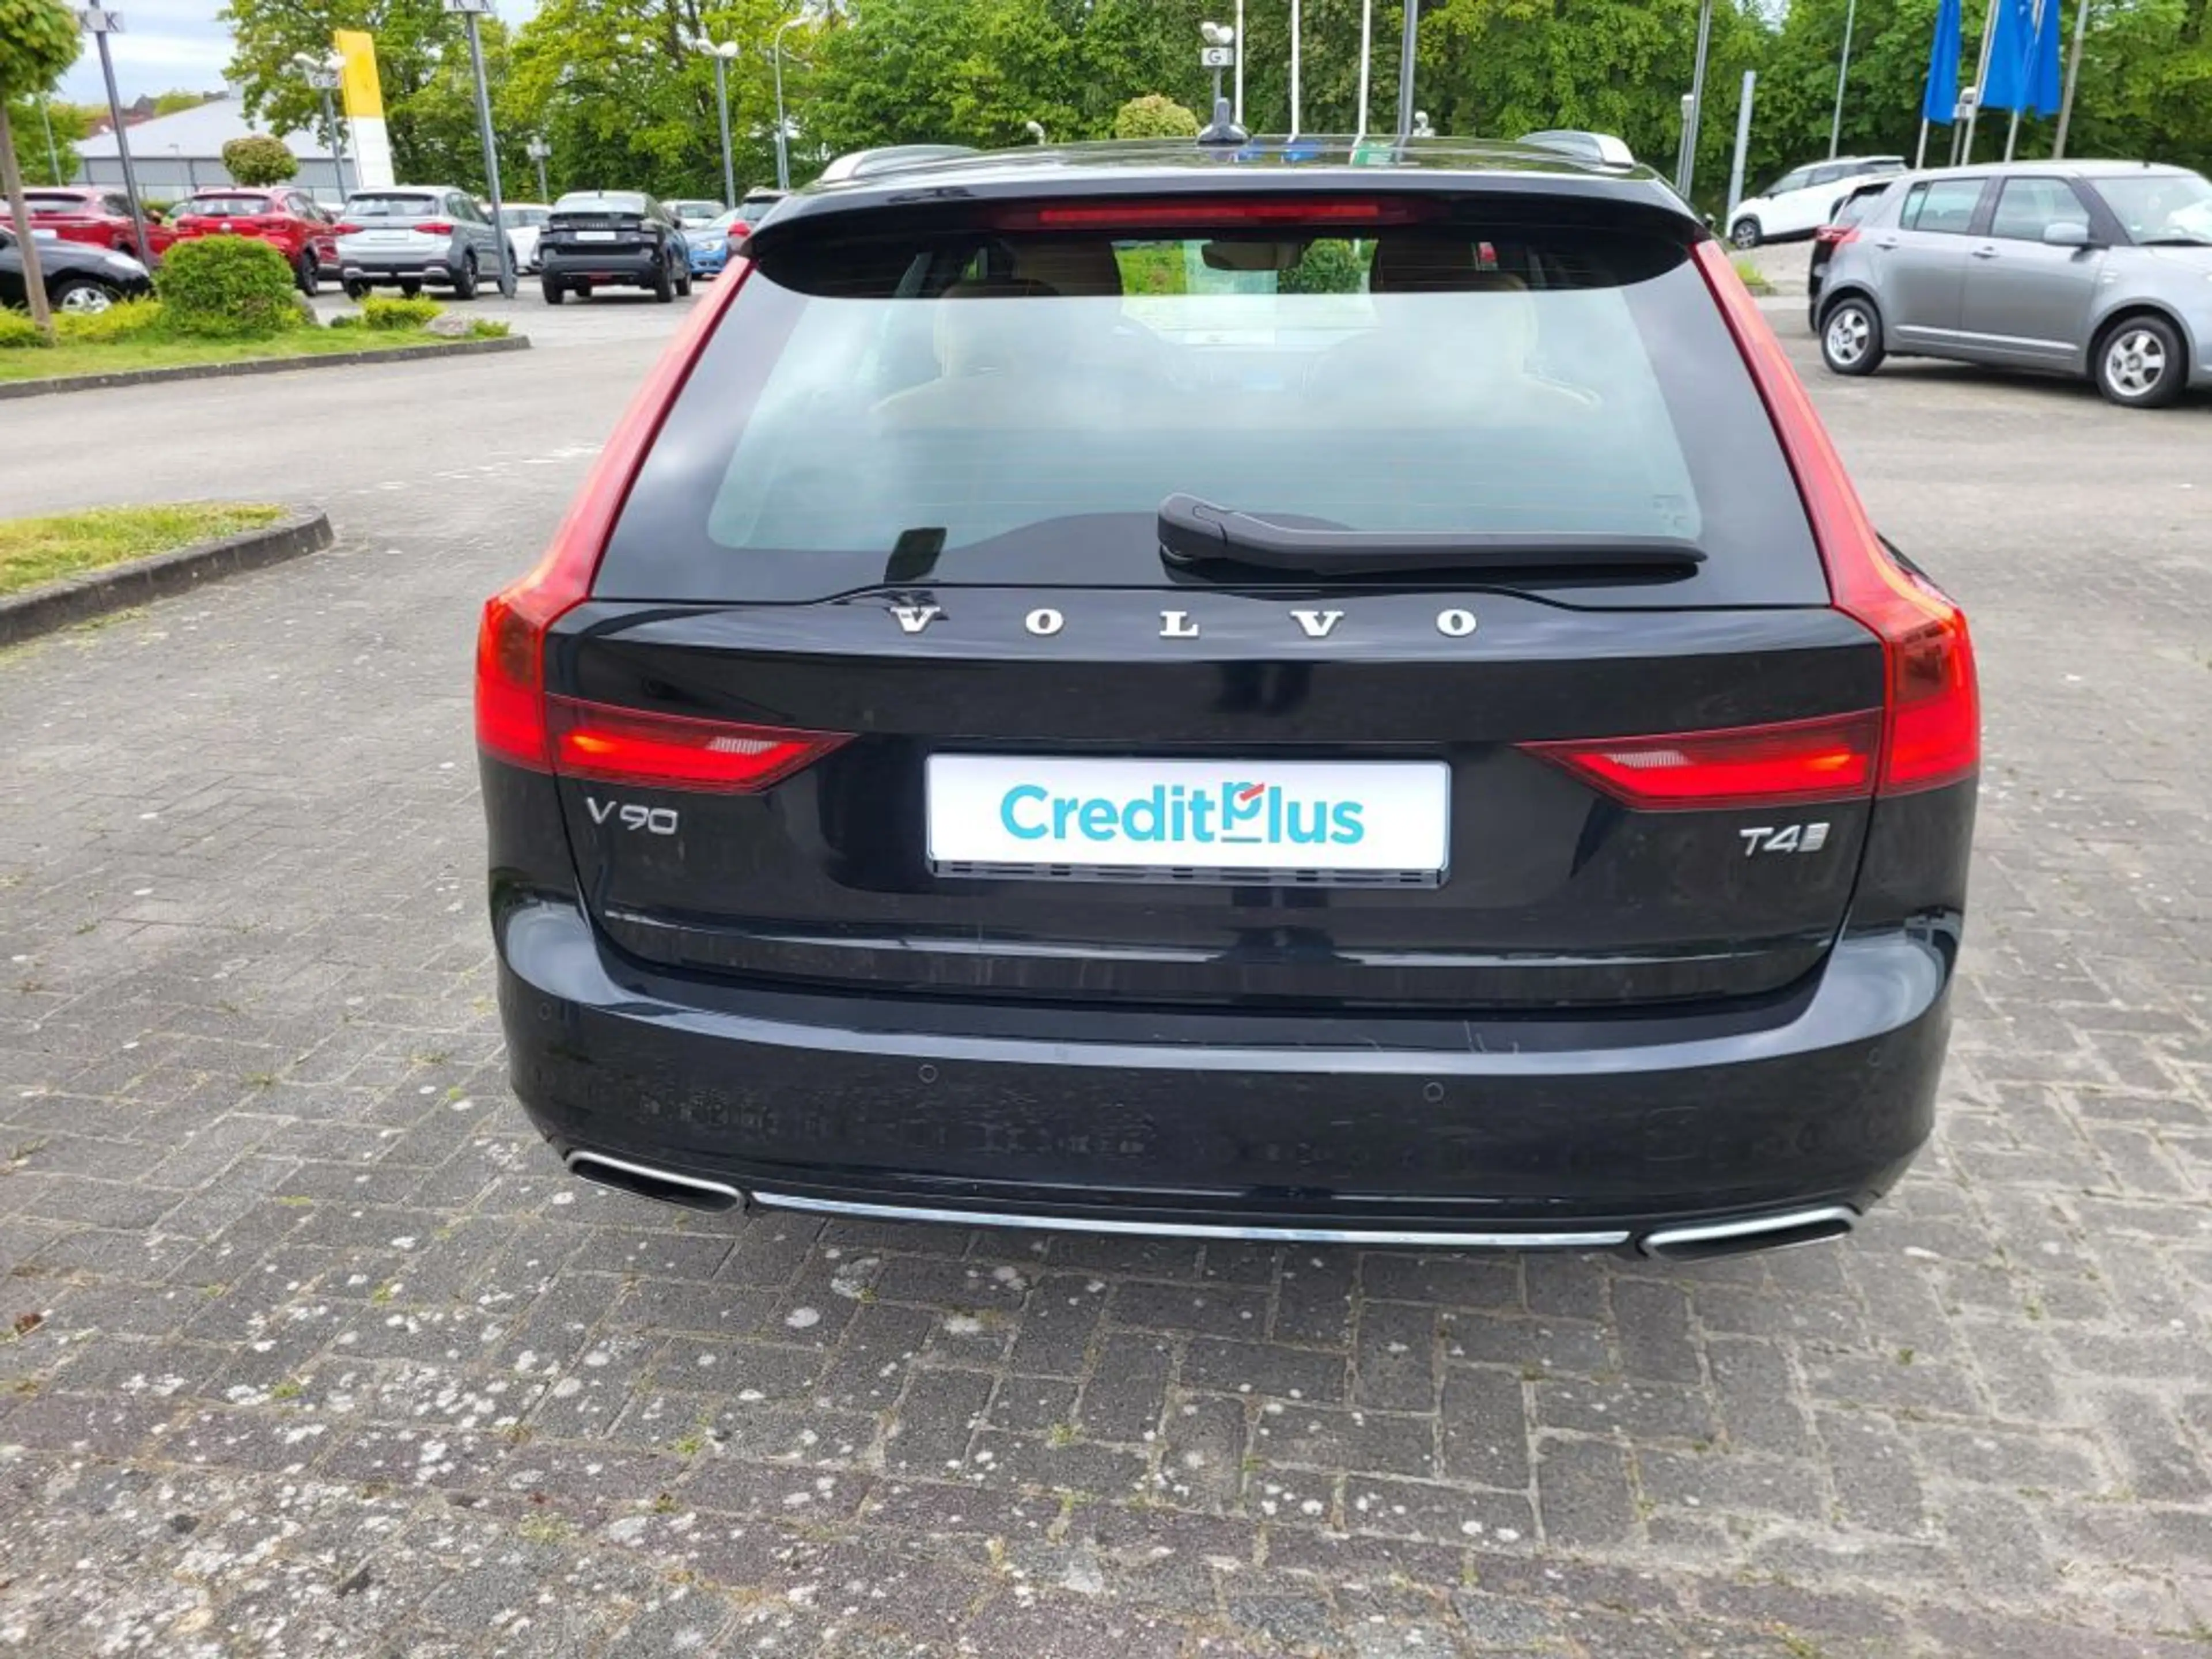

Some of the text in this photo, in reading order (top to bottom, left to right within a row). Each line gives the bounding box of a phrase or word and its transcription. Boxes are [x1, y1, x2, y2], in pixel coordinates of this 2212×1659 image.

[1207, 50, 1222, 63] G
[891, 607, 1477, 637] VOLVO
[586, 797, 679, 835] V90
[1001, 782, 1364, 844] CreditPlus
